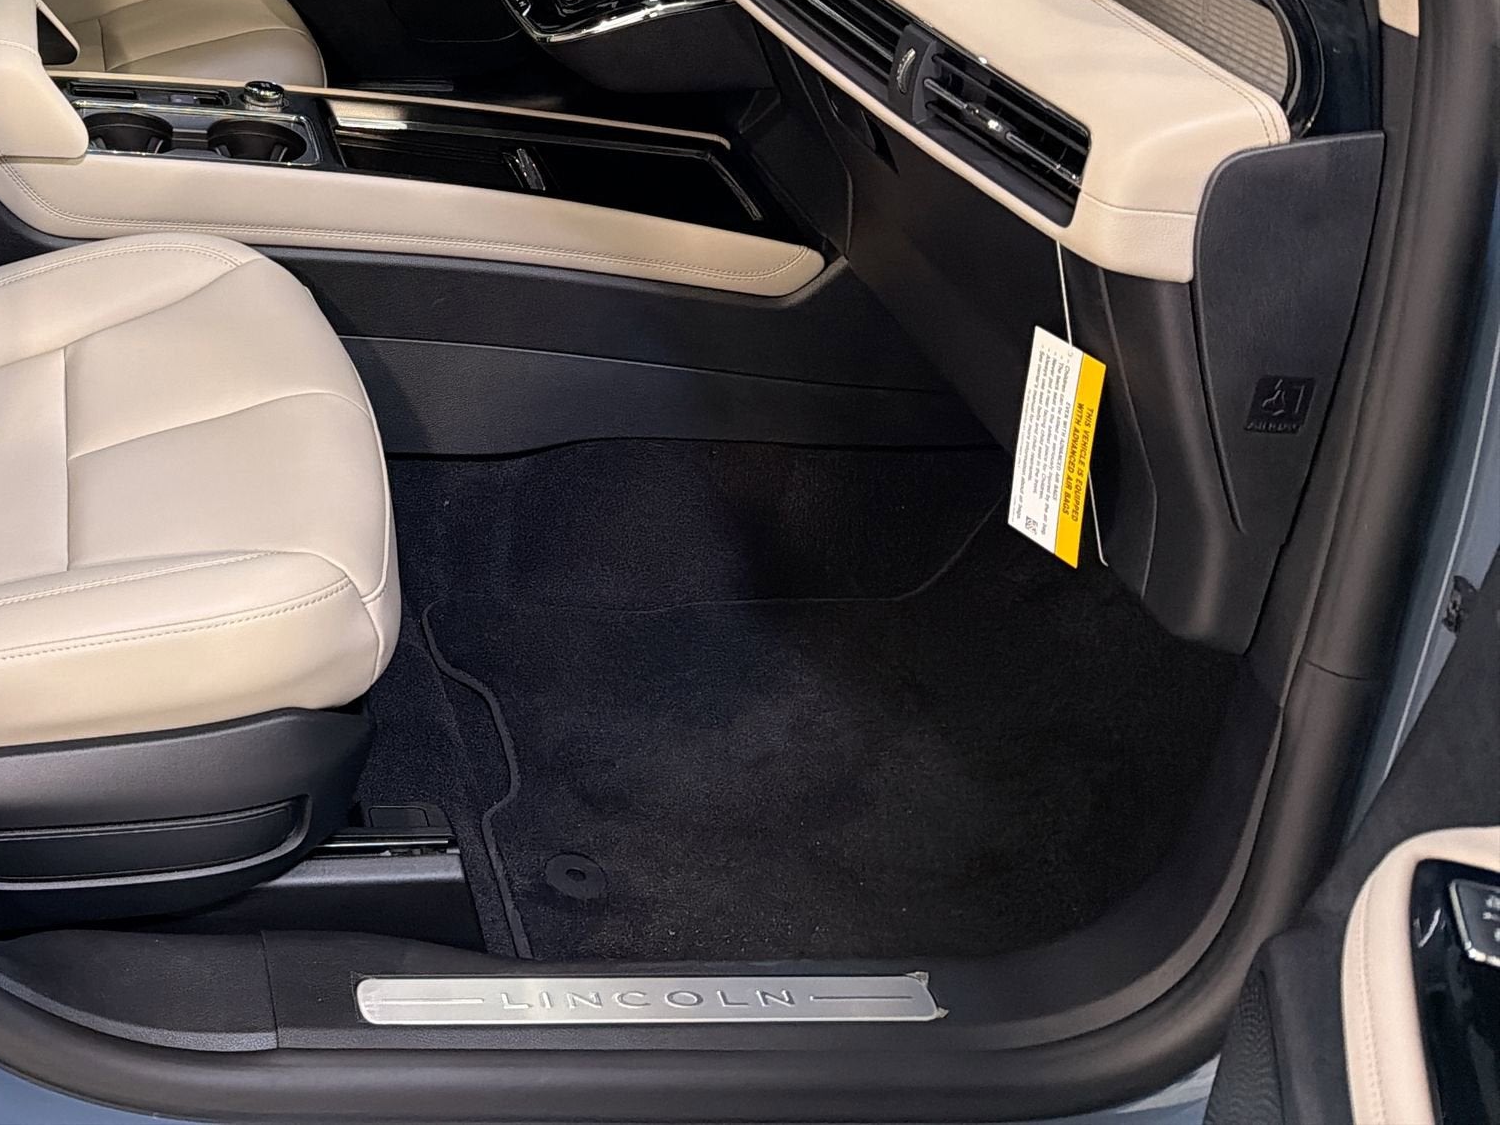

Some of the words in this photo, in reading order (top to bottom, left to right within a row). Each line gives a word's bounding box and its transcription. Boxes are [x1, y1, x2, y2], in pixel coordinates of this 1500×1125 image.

[1074, 400, 1084, 426] WITH
[1084, 405, 1093, 428] THIS
[1067, 426, 1080, 474] ADVANCED
[1078, 428, 1090, 468] VEHICLE
[1065, 474, 1073, 491] AIR
[1077, 467, 1084, 478] IS
[1061, 490, 1071, 515] BAGS
[1070, 478, 1083, 523] EQUIPPED
[500, 988, 796, 1010] LINCOLN
